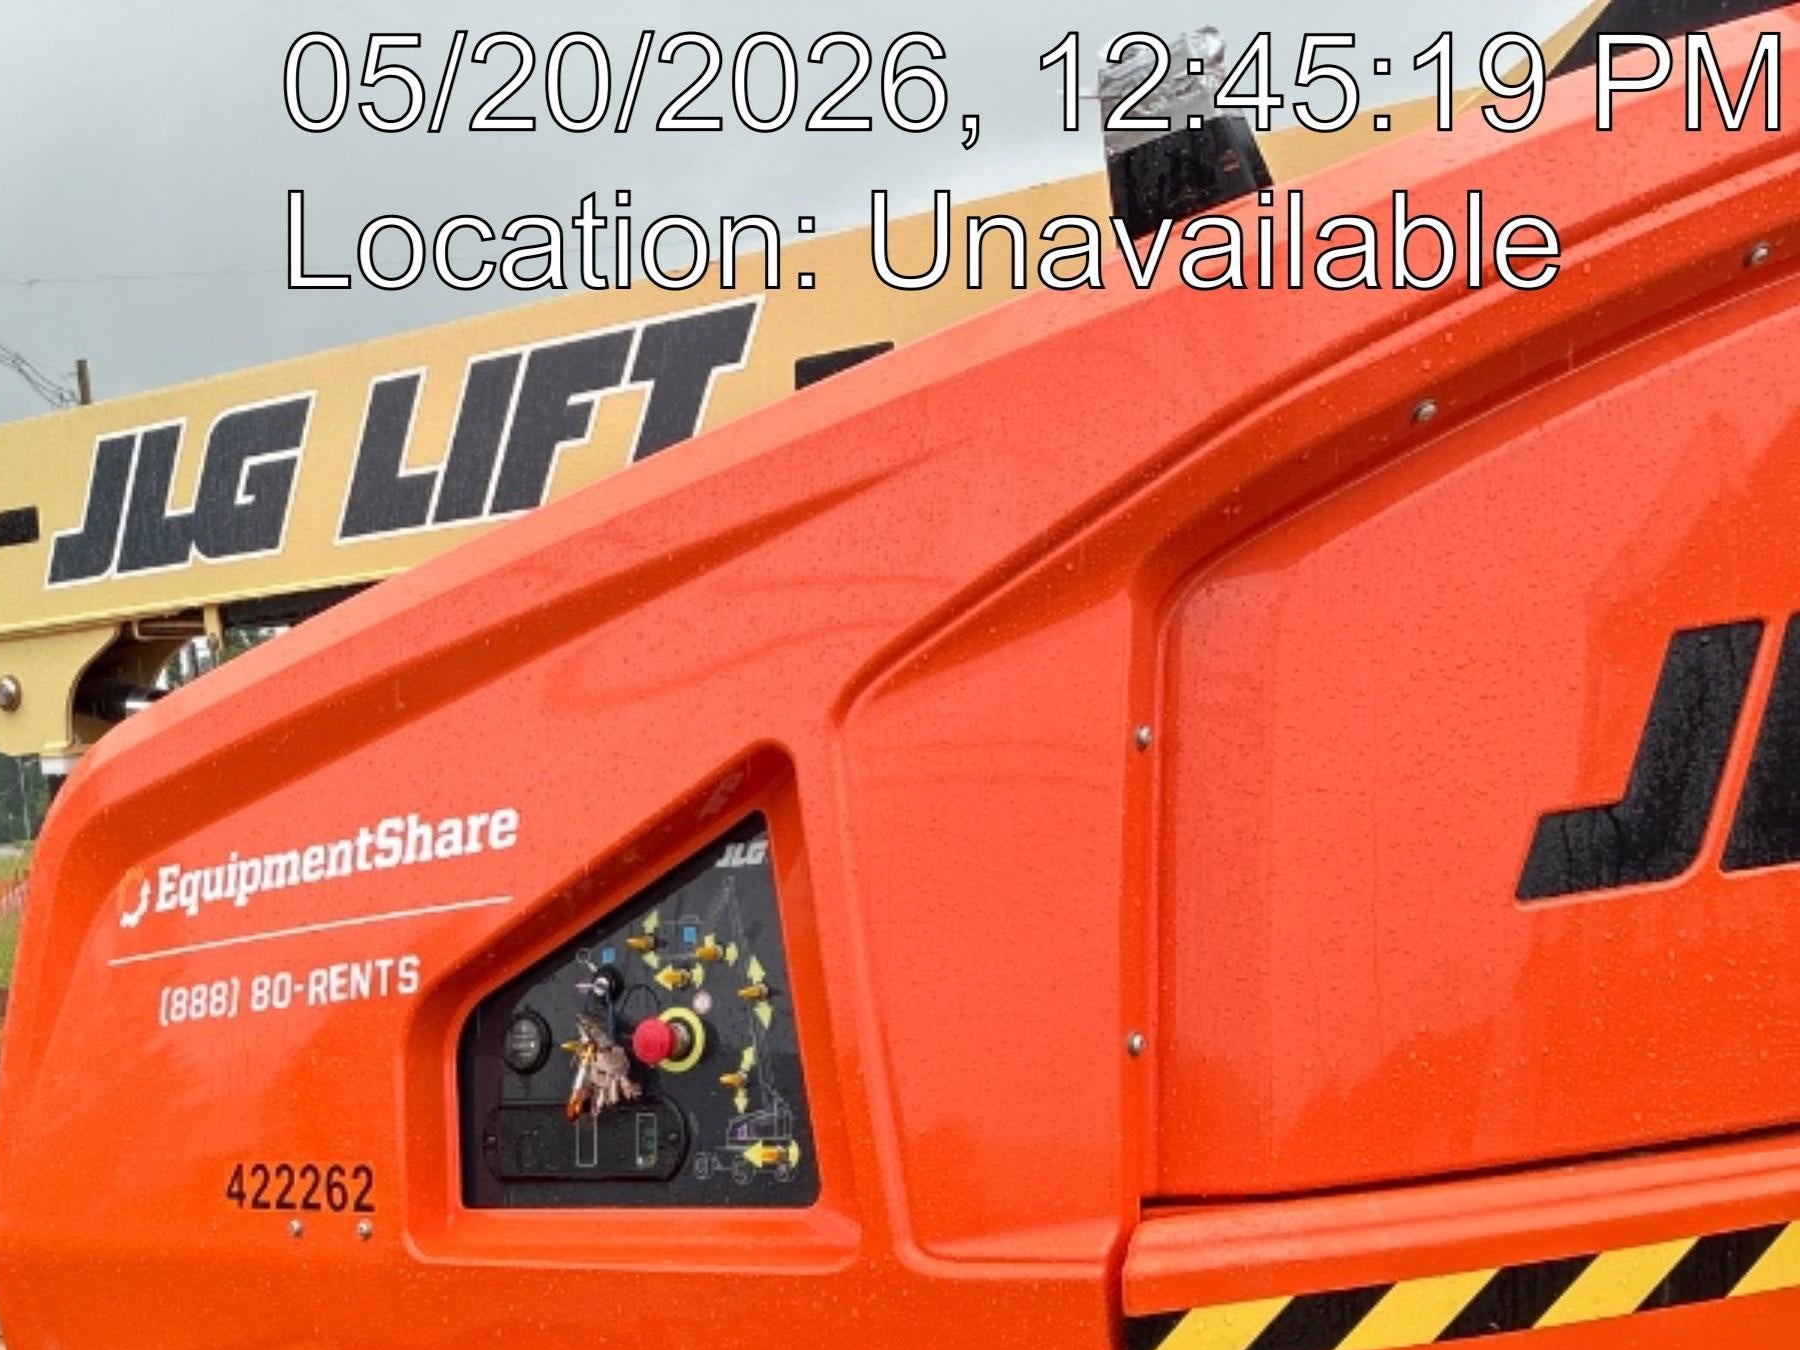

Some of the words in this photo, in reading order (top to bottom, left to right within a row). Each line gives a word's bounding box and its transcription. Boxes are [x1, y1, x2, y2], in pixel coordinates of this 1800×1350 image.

[46, 392, 315, 588] JLG
[337, 294, 764, 546] LIFT
[154, 807, 519, 916] EquipmentShare
[714, 839, 769, 868] JLG
[158, 977, 240, 1027] (888)
[250, 954, 421, 1013] 80-RENTS
[226, 1164, 375, 1213] 422262
